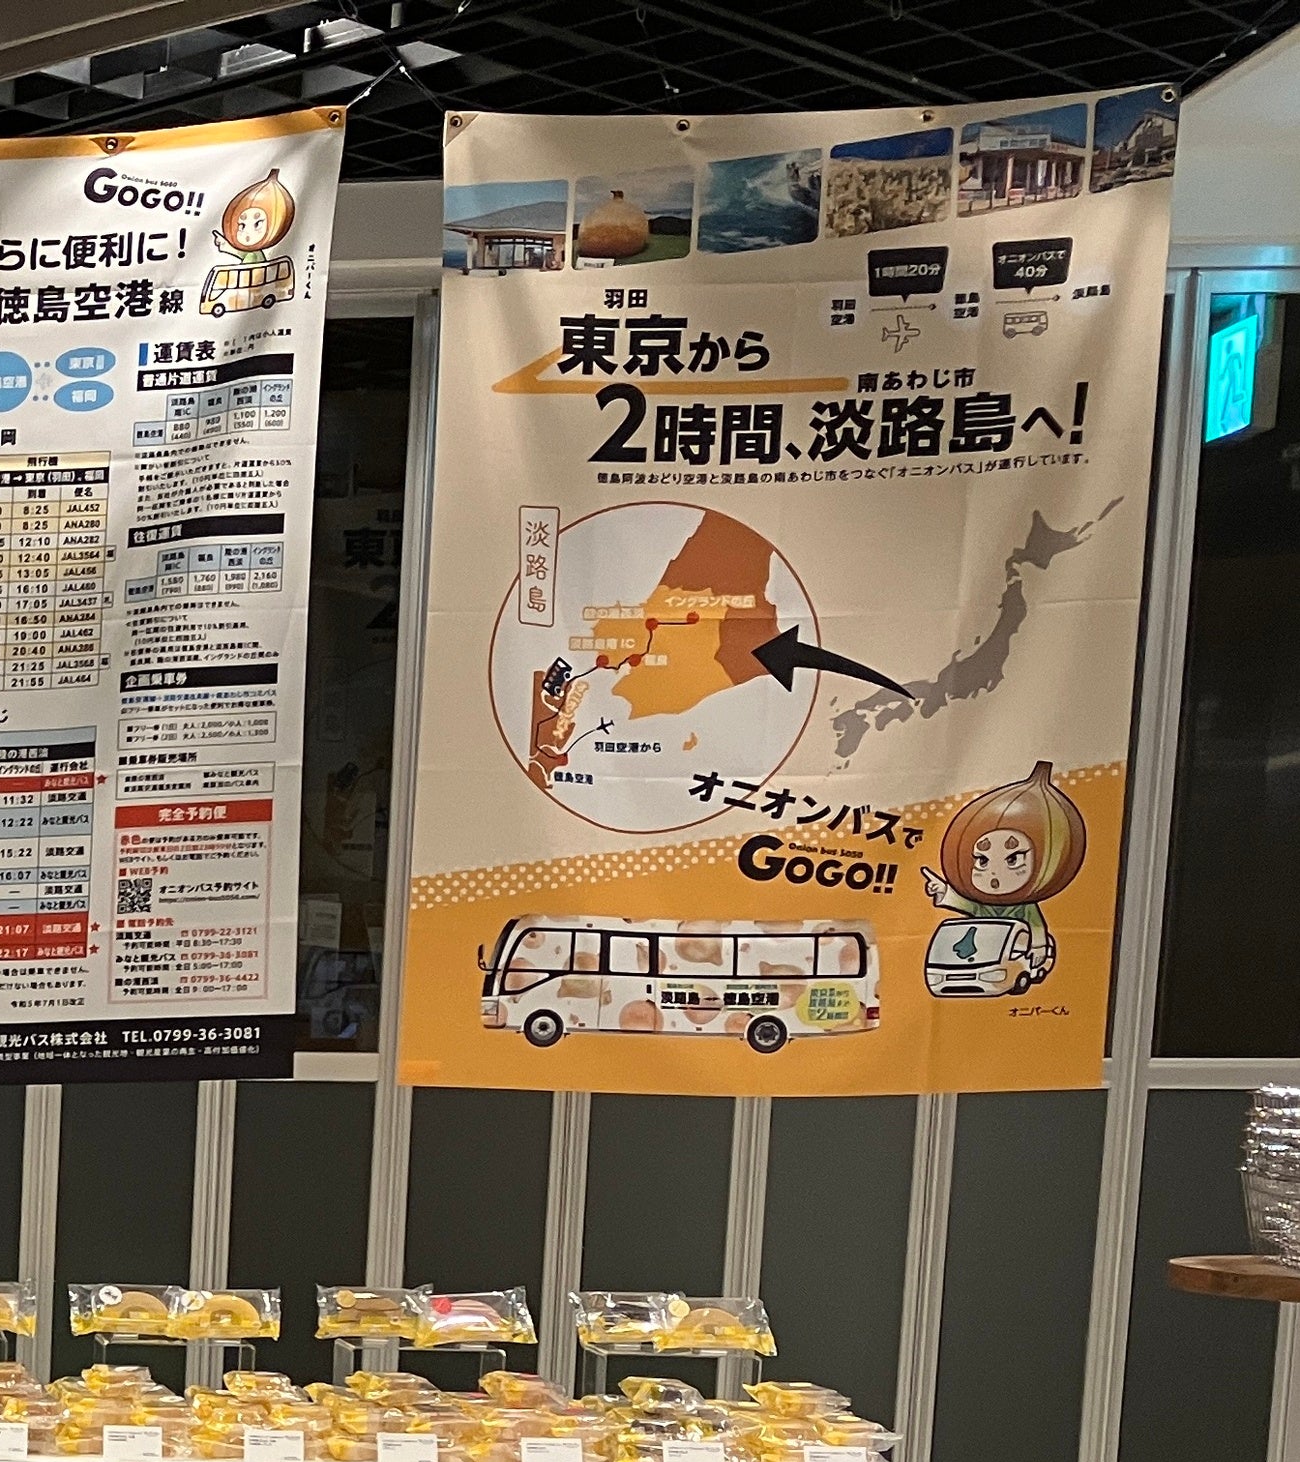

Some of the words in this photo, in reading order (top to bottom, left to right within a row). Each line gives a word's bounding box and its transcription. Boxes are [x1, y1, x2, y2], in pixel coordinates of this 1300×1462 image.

[84, 167, 205, 216] GOGO!!
[1014, 265, 1048, 278] 40分
[605, 288, 648, 309] 羽田
[154, 340, 216, 364] 運賃表
[558, 314, 770, 377] 東京から
[857, 367, 976, 393] 南あわじ市
[588, 381, 1090, 466] 2時間、淡路島へ！
[23, 505, 49, 515] 8:25
[67, 504, 100, 513] JAL452
[19, 536, 50, 546] 12:10
[18, 552, 50, 562] 12:40
[525, 520, 550, 613] 淡路島
[16, 599, 48, 609] 17:05
[12, 646, 46, 656] 20:40
[12, 661, 45, 672] 21:25
[3, 795, 34, 805] 11:32
[158, 806, 227, 822] 完全予約便
[688, 771, 923, 849] オニオンバスで
[1, 818, 33, 827] 12:22
[737, 834, 898, 895] GOGO!!
[159, 881, 259, 894] オニオンバス予約サイト
[1008, 1005, 1069, 1017] オニバーくん
[122, 1026, 260, 1043] TEL.0799-36-3081
